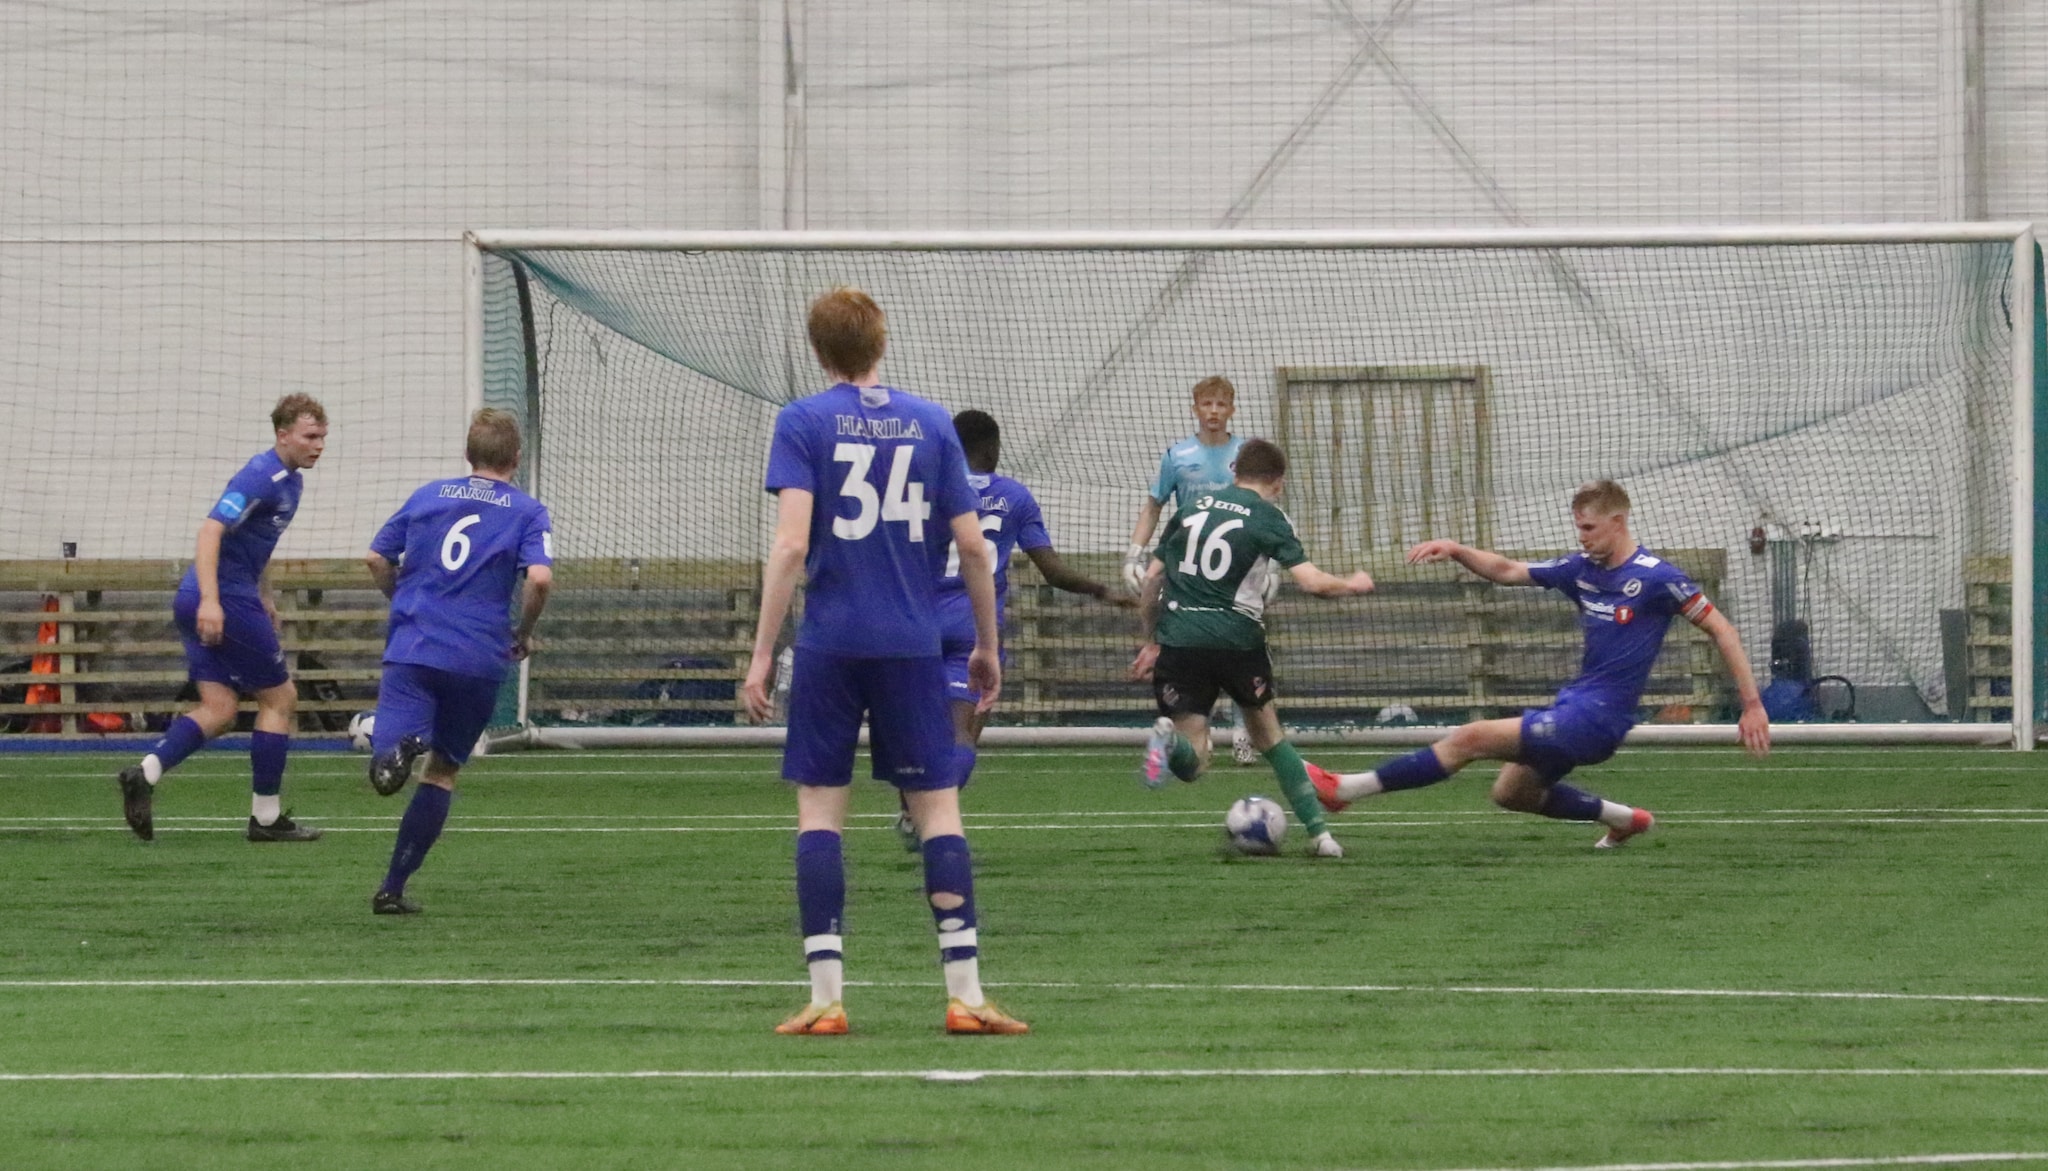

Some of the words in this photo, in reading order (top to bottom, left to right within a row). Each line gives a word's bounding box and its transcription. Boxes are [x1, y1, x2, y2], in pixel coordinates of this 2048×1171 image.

[835, 414, 924, 440] HARILA
[438, 484, 512, 508] HARILA
[832, 442, 931, 542] 34
[1214, 500, 1251, 516] EXTRA
[440, 513, 481, 571] 6
[1178, 510, 1244, 581] 16
